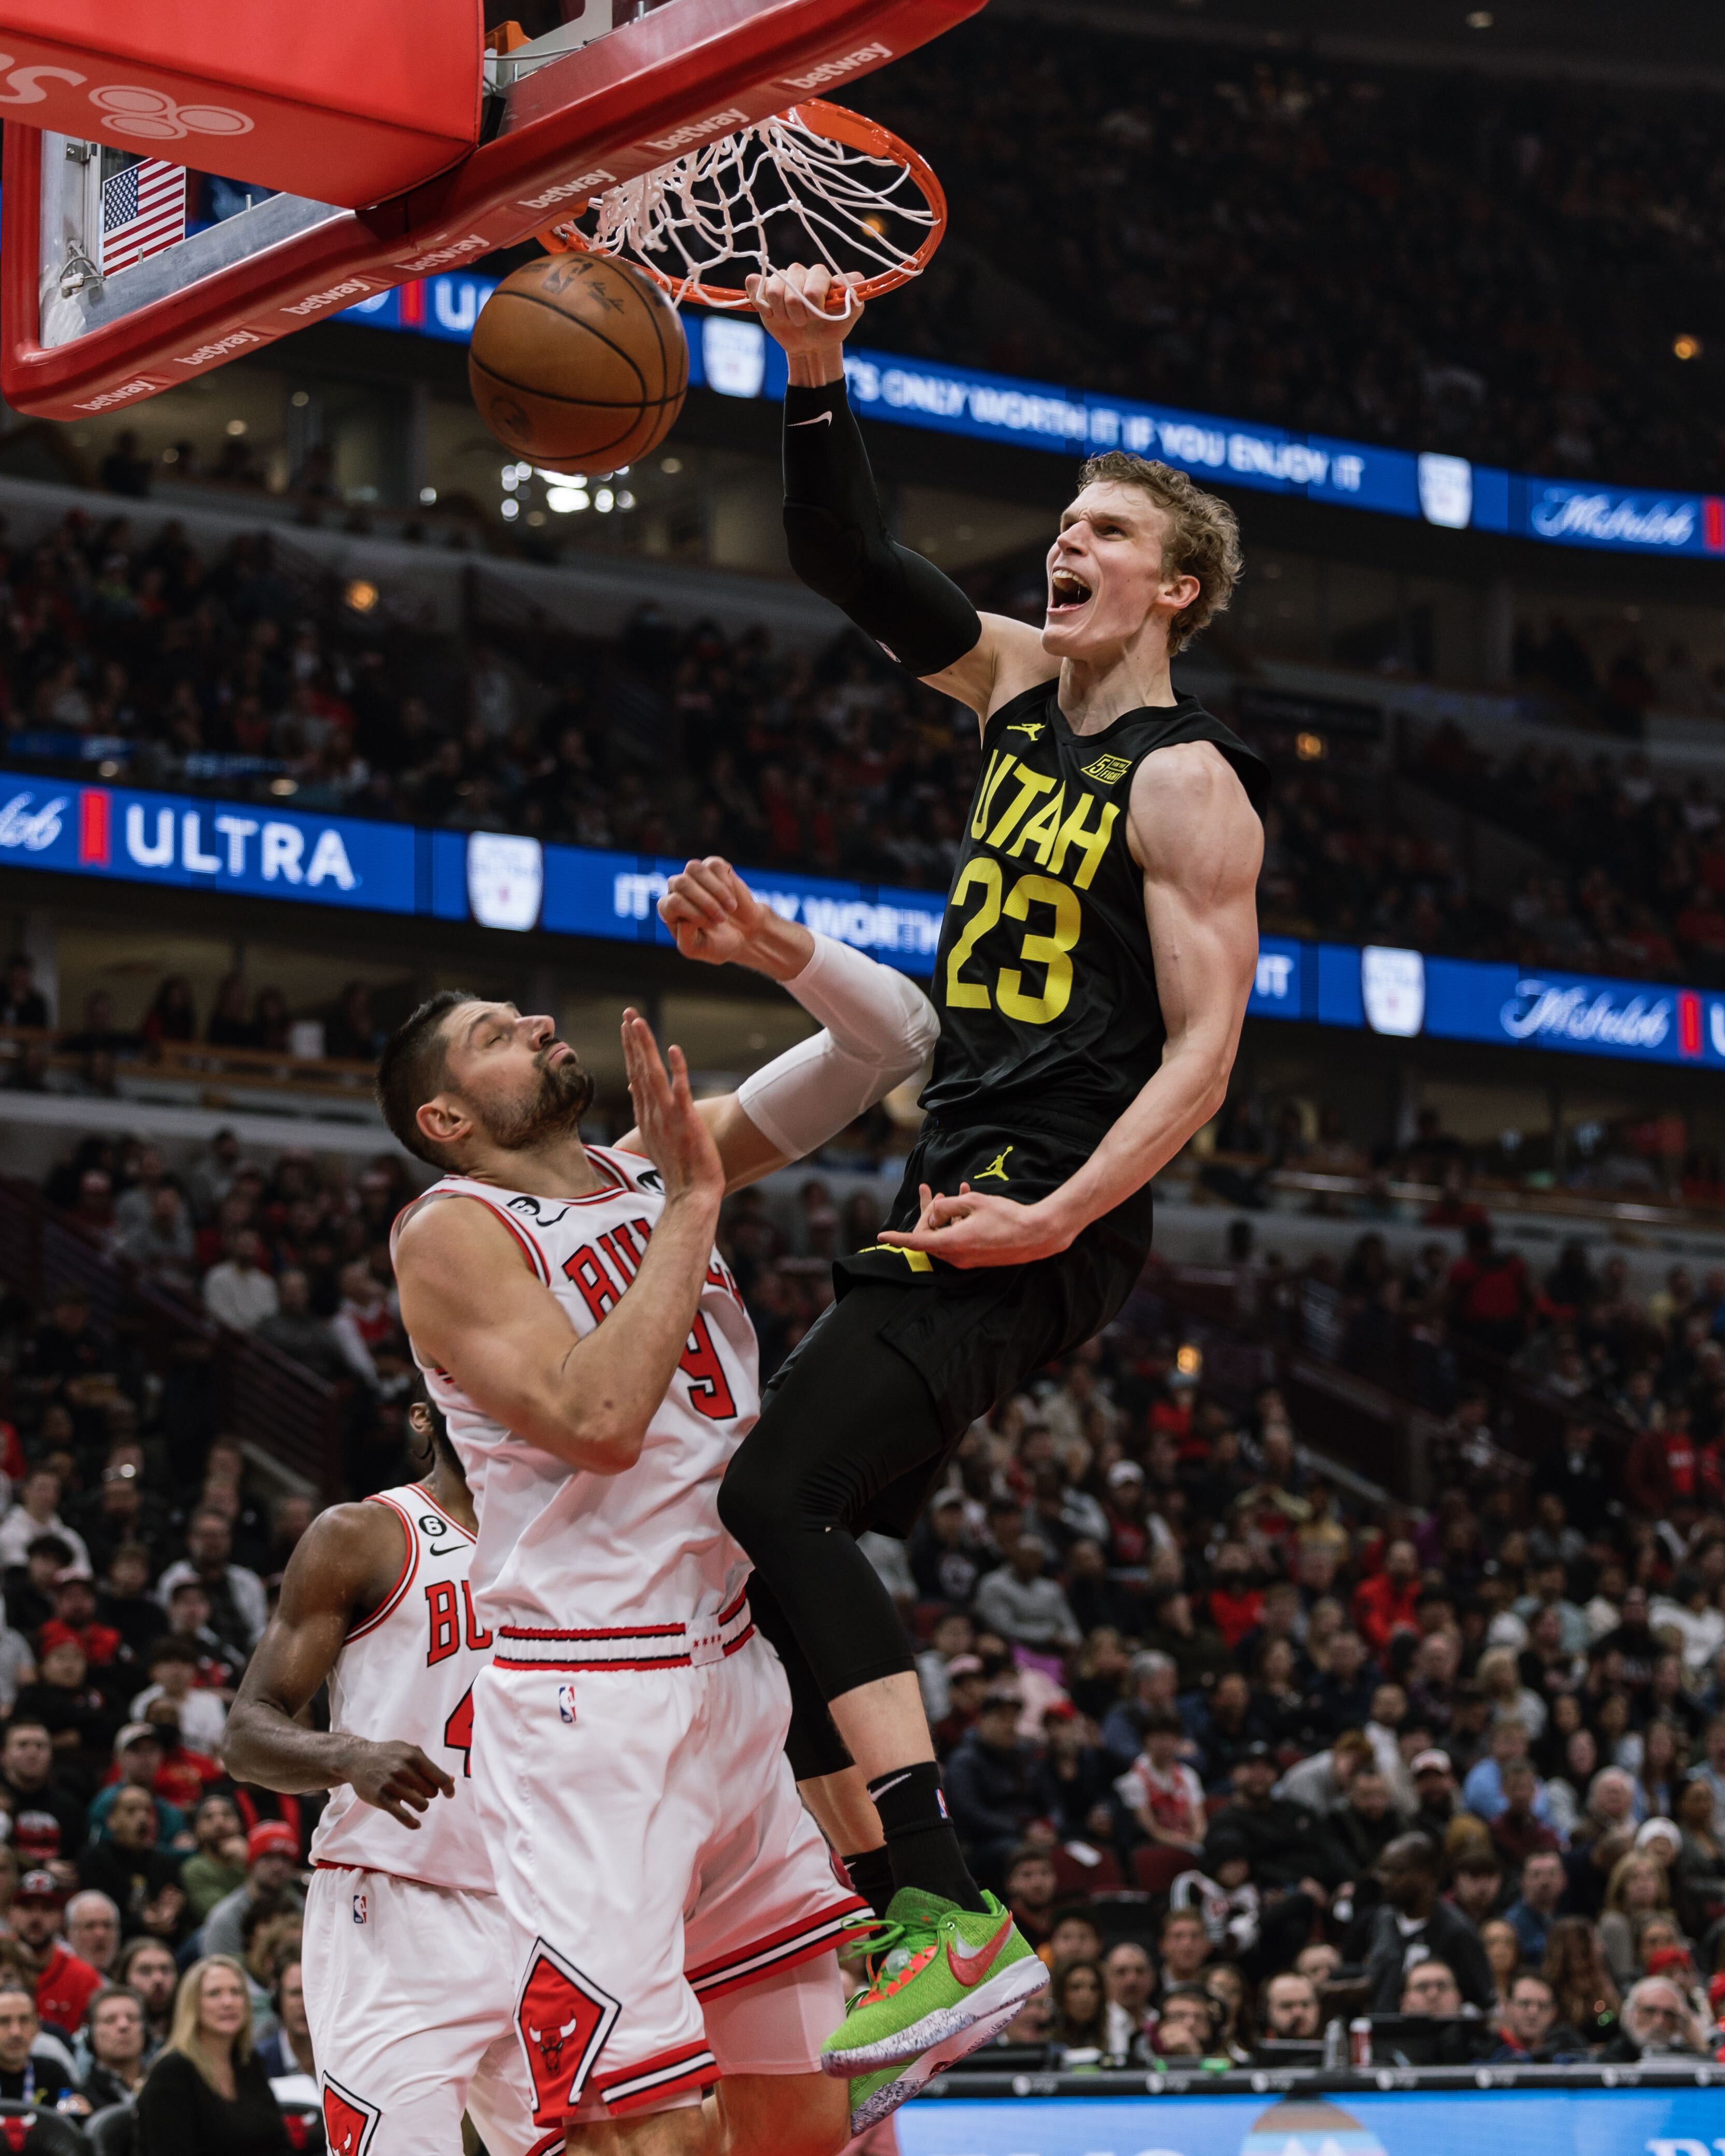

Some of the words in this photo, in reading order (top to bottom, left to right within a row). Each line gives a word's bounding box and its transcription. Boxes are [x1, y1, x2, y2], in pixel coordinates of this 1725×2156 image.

[783, 41, 893, 91] betway
[645, 107, 750, 151] betway
[519, 167, 617, 209] betway
[394, 233, 490, 273] betway
[280, 276, 371, 317] betway
[173, 329, 260, 366] betway
[73, 376, 156, 412] betway
[1156, 421, 1226, 467] YOU
[1331, 454, 1365, 492] IT
[1089, 758, 1111, 774] 5
[971, 749, 1121, 890] UTAH
[125, 803, 362, 890] ULTRA
[946, 857, 1081, 1024] 23
[422, 1516, 444, 1536] 6
